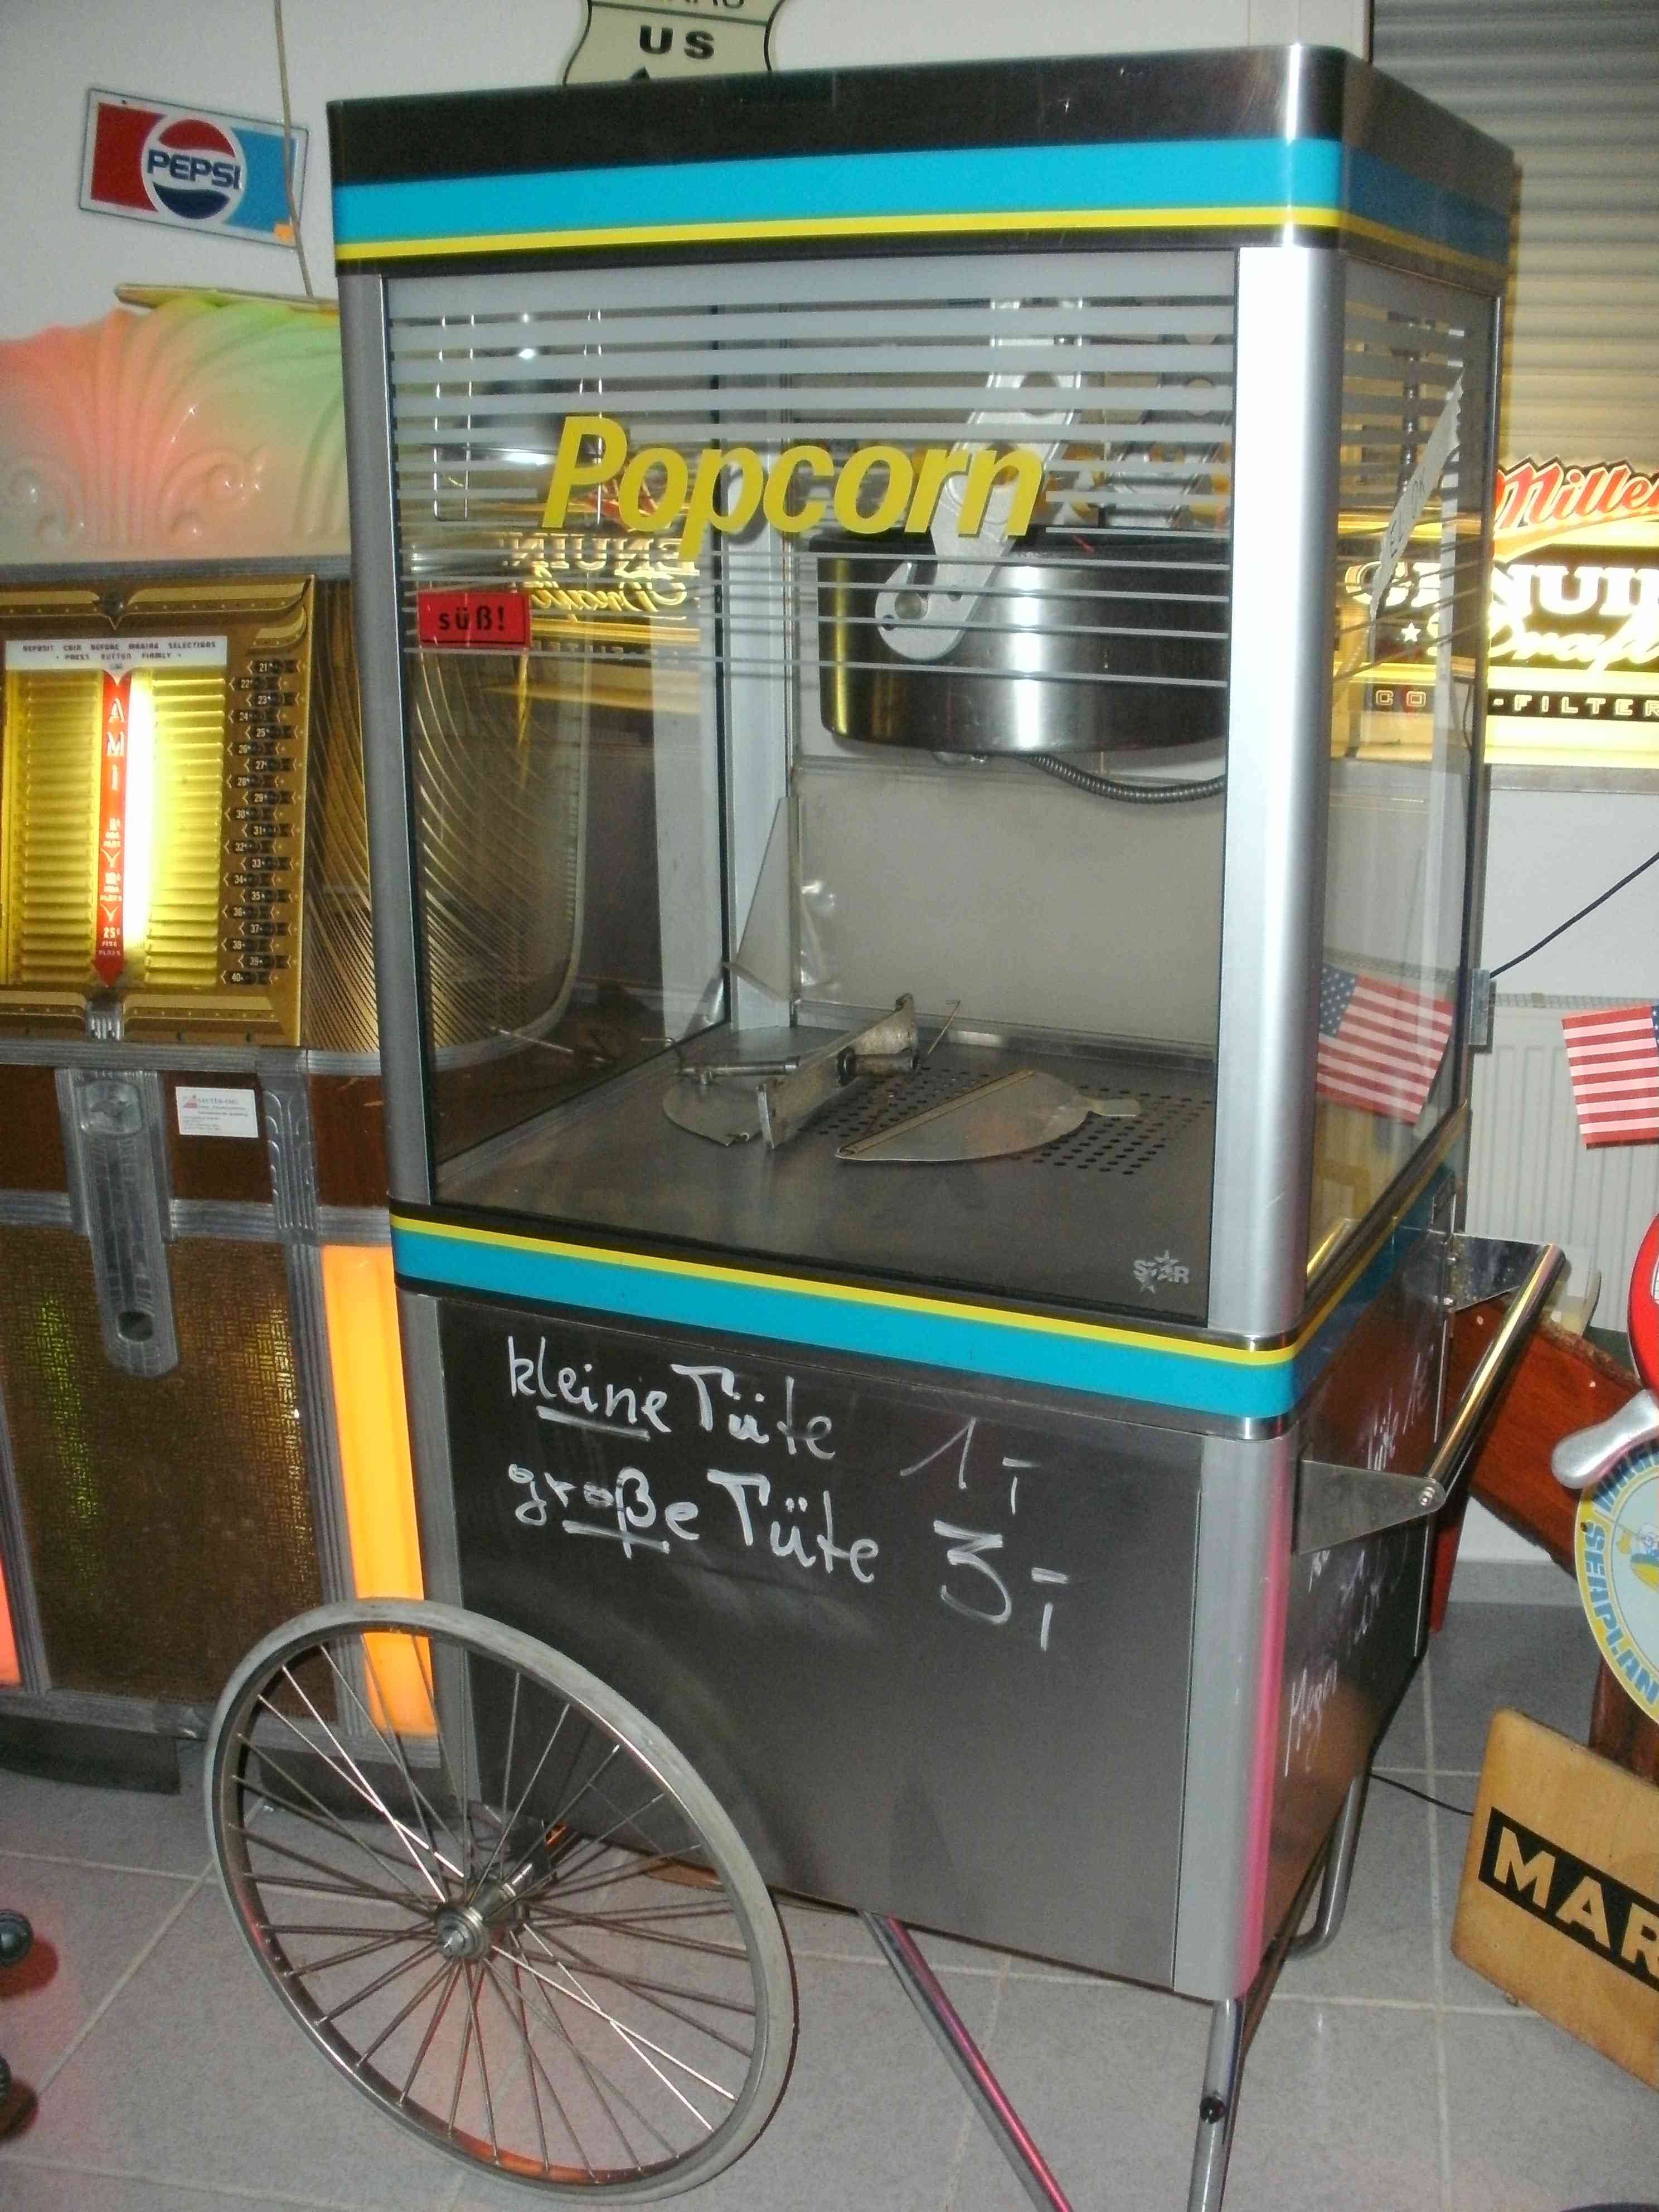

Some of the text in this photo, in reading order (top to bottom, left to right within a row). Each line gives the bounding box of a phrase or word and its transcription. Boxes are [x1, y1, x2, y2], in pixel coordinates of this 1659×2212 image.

[639, 25, 715, 60] US
[147, 148, 242, 190] PEPSI
[542, 416, 1041, 563] Popcorn
[439, 605, 505, 631] süß!
[259, 663, 268, 672] 21
[241, 679, 250, 688] 22
[258, 696, 267, 705] 23
[239, 711, 248, 721] 24
[256, 728, 266, 737] 25
[255, 760, 264, 770] 27
[236, 809, 245, 818] 30
[254, 826, 263, 835] 31
[235, 842, 244, 851] 32
[252, 859, 261, 868] 33
[234, 875, 243, 884] 34
[251, 891, 260, 900] 35
[250, 924, 259, 933] 37
[231, 973, 241, 982] 40
[507, 1336, 673, 1434] kleine
[670, 1363, 836, 1461] Tüte
[706, 1468, 880, 1584] Tüte
